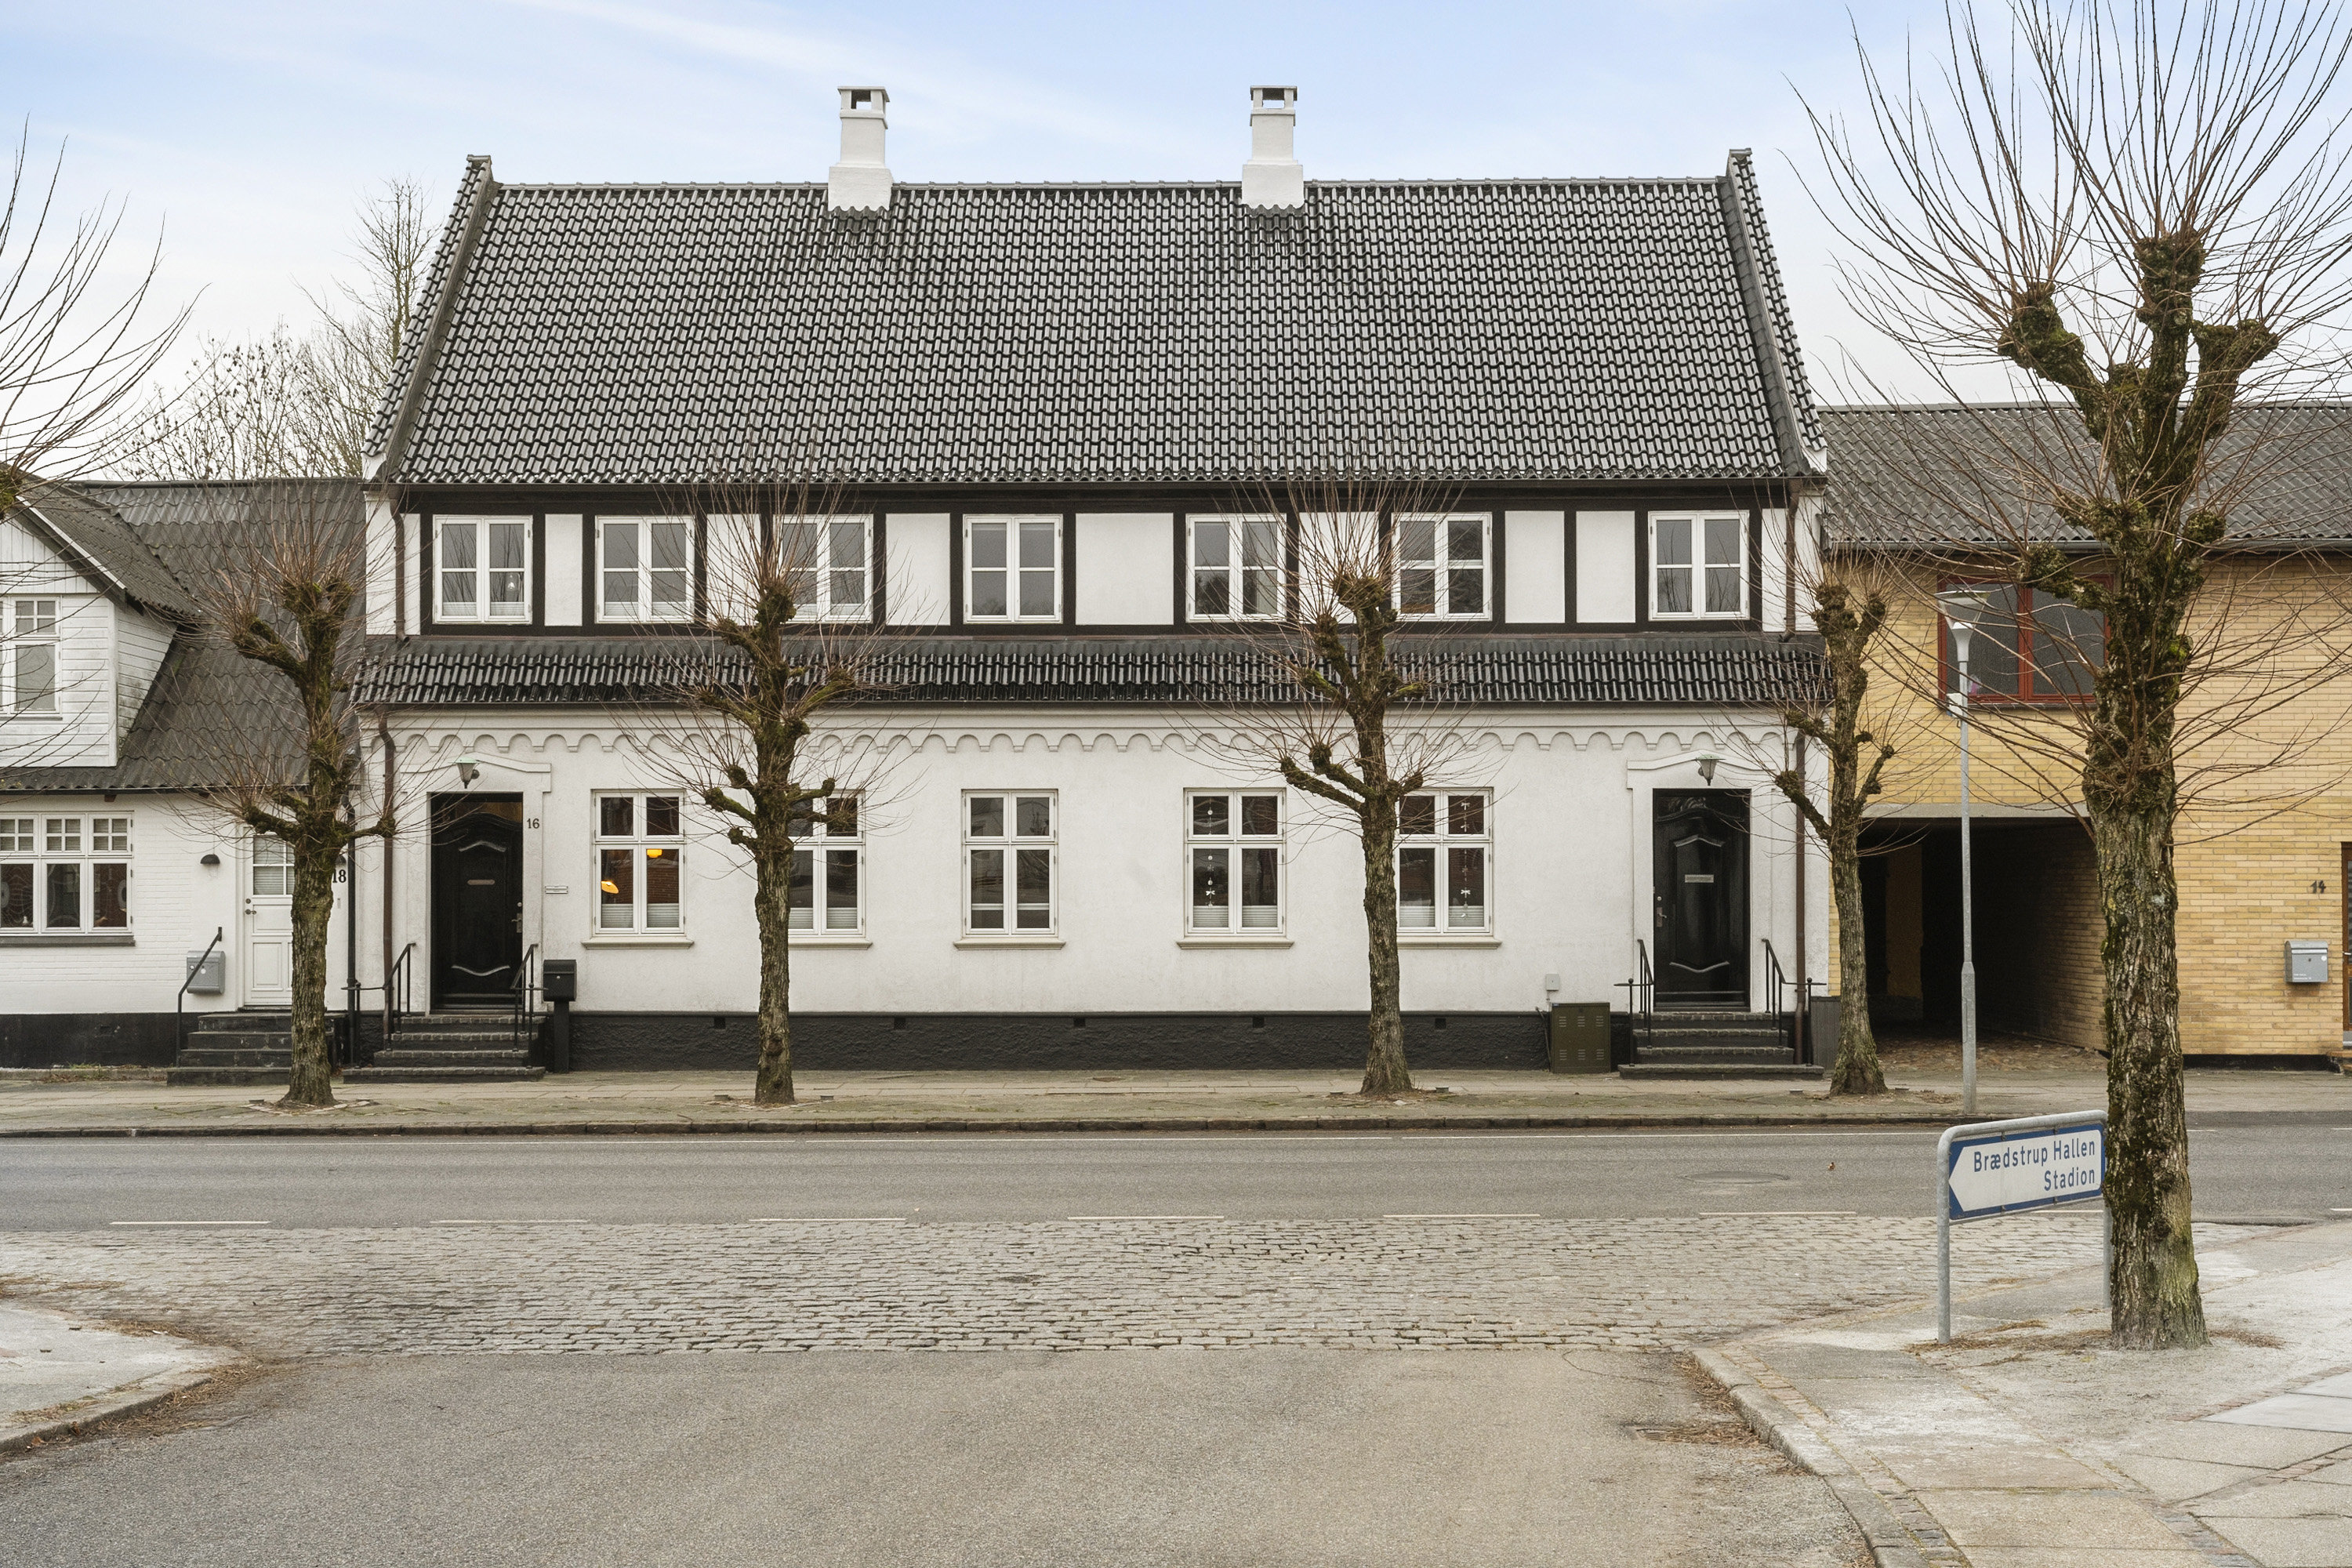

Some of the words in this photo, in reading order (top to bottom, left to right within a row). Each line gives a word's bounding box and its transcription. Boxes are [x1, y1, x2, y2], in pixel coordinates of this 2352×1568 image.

[526, 818, 540, 829] 16
[332, 868, 347, 884] 18
[2310, 879, 2327, 895] 14
[1973, 1145, 2048, 1173] Brædstrup
[2053, 1138, 2095, 1161] Hallen
[2044, 1167, 2095, 1192] Stadion
